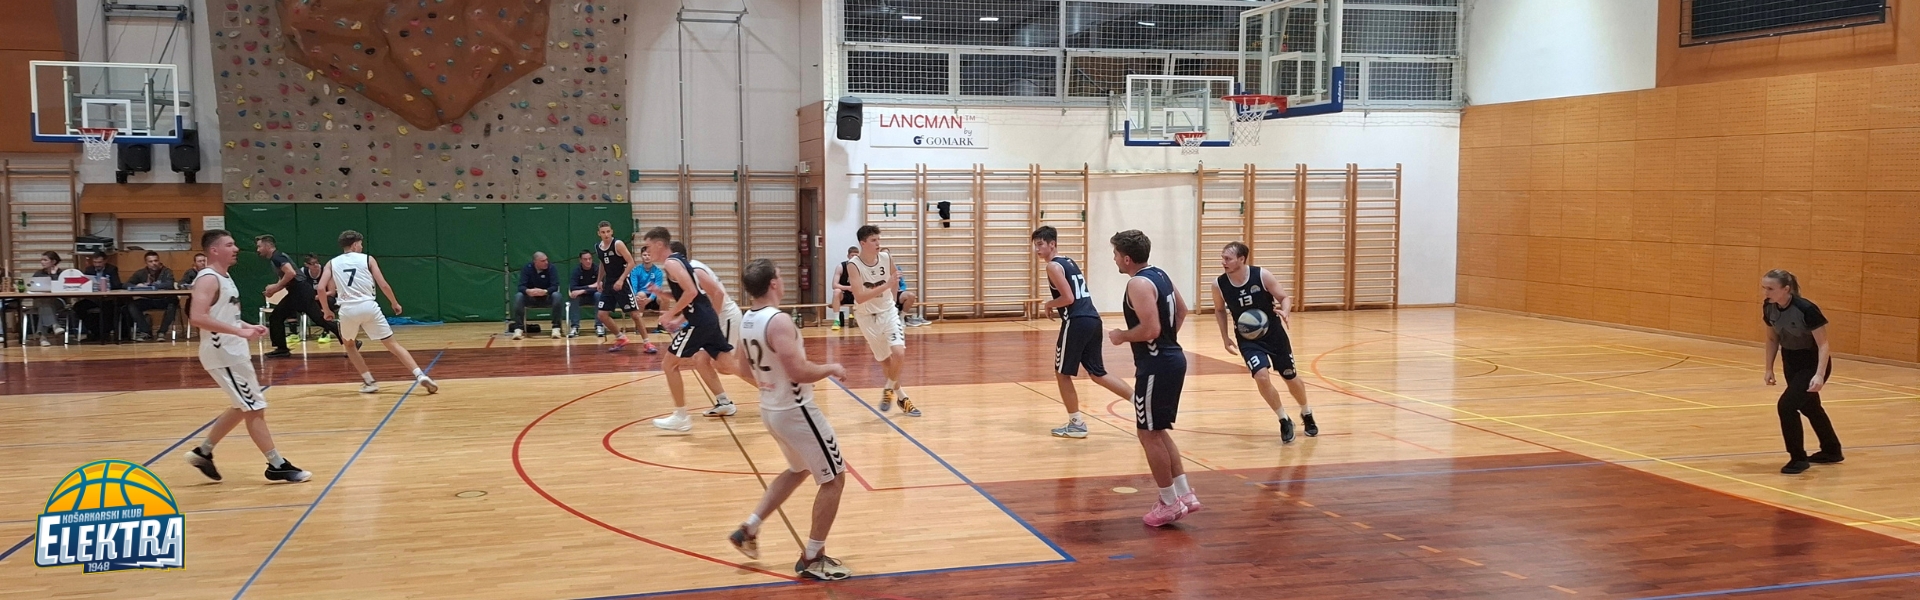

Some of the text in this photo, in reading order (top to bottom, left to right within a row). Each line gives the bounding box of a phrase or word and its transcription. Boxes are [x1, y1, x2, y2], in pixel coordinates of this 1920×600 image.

[880, 114, 962, 128] LANCMAN
[963, 128, 973, 136] by
[926, 136, 974, 146] GOMARK
[880, 266, 886, 276] 3
[342, 268, 357, 287] 7
[1071, 274, 1090, 300] 12
[1238, 295, 1253, 307] 13
[891, 333, 897, 341] 3
[1247, 355, 1260, 370] 13
